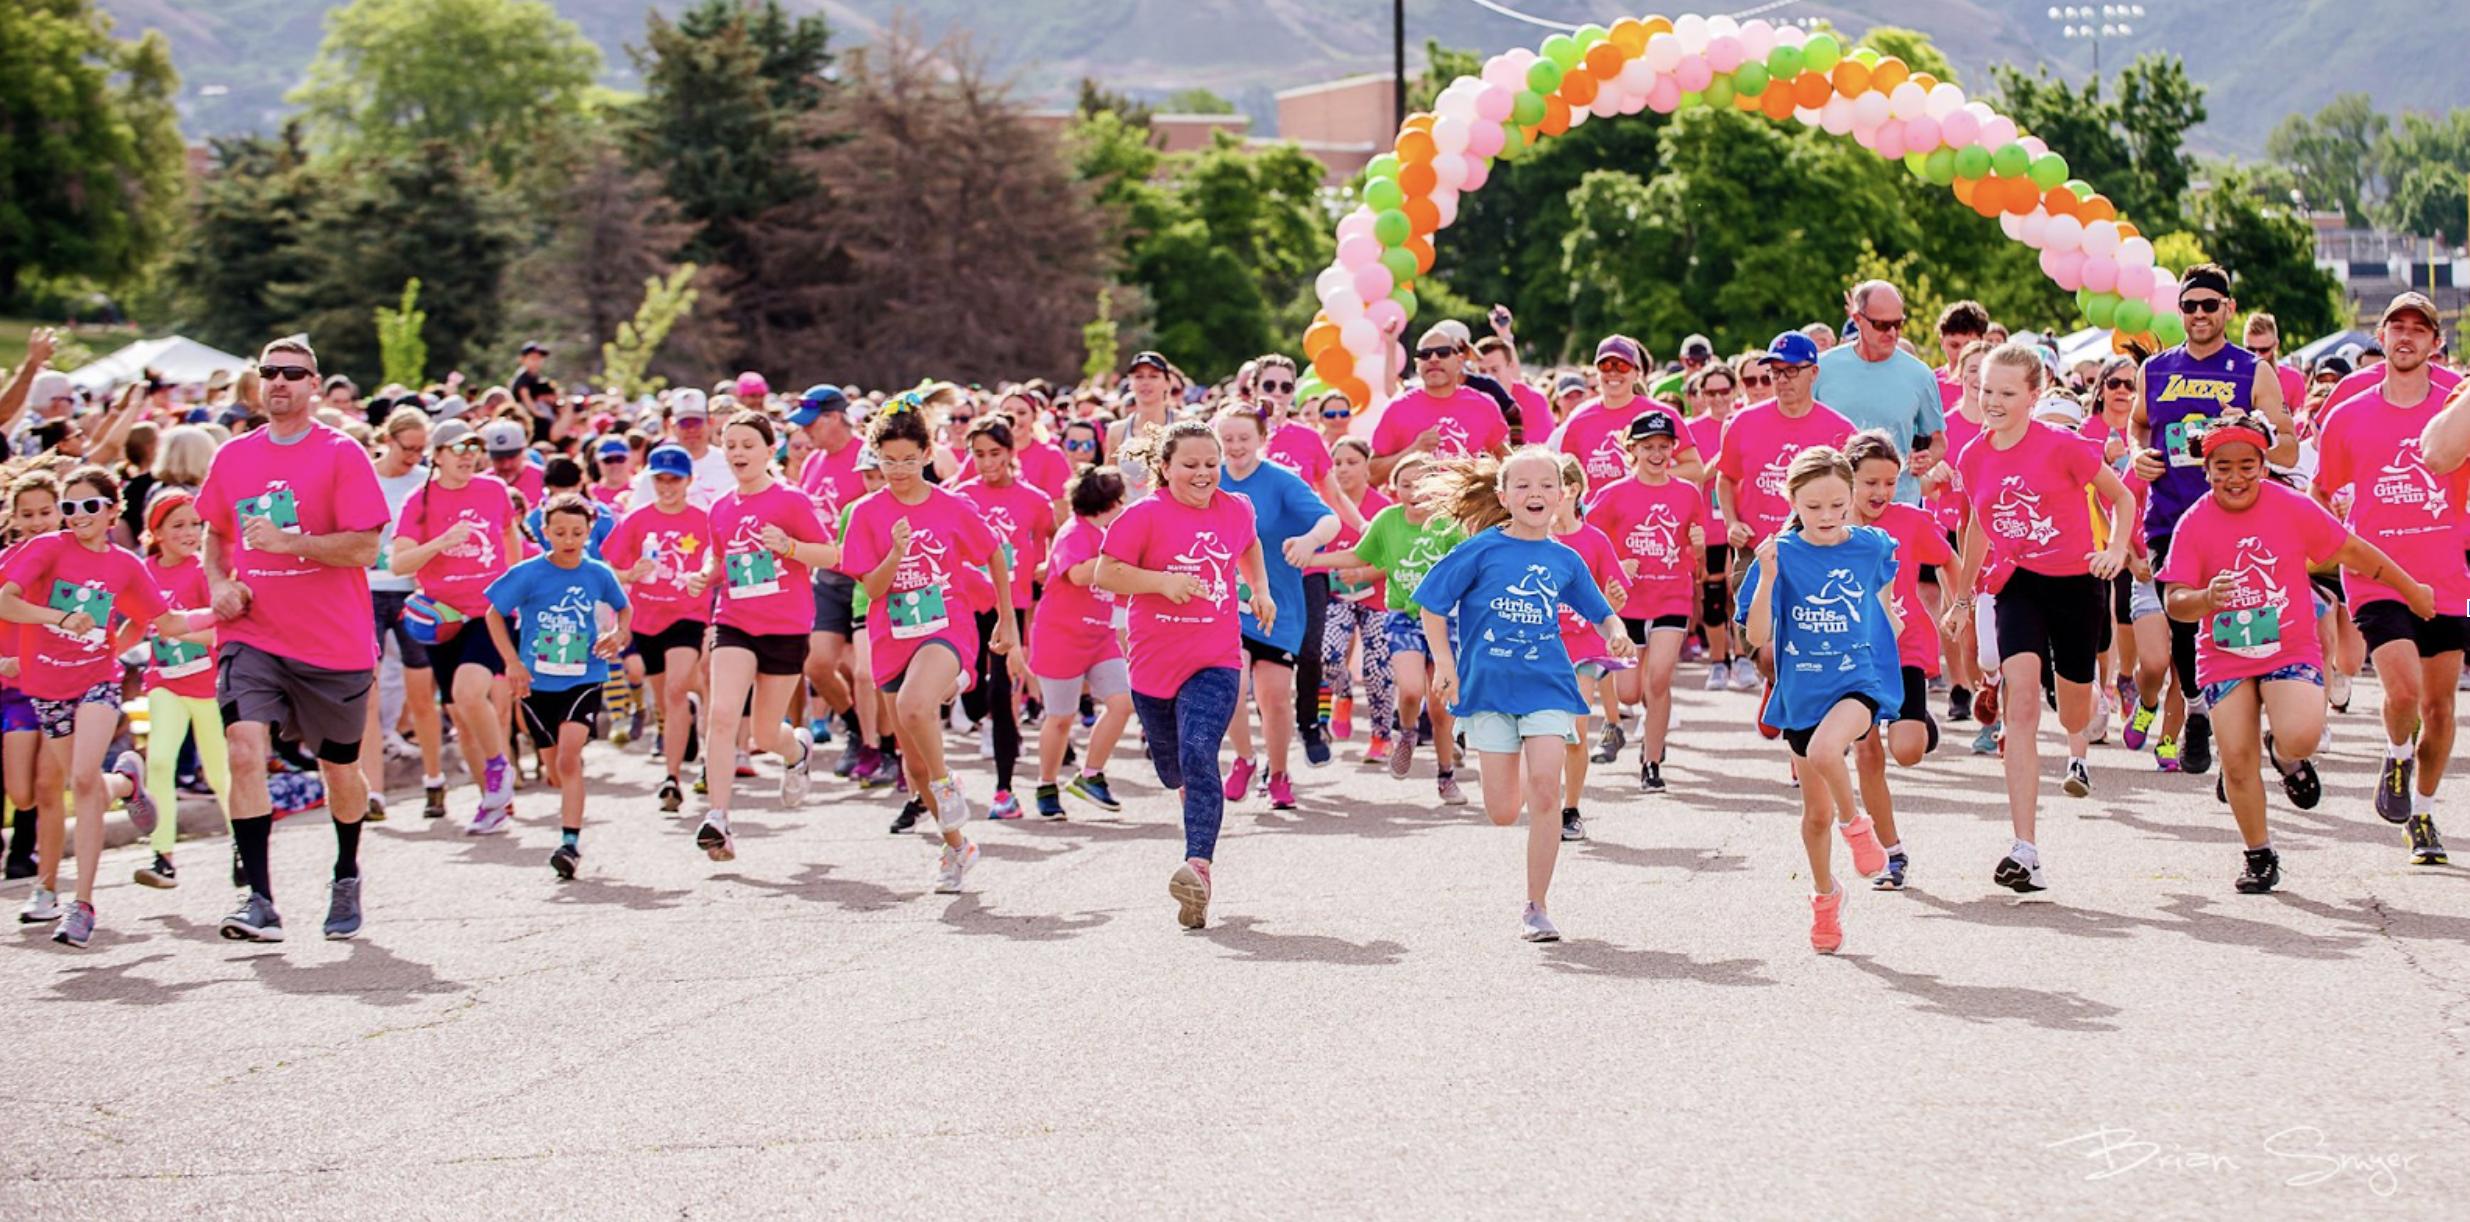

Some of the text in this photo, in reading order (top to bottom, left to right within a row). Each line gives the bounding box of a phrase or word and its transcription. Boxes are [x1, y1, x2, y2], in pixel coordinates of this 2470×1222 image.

[2156, 374, 2237, 404] LAKERS
[2374, 482, 2412, 497] Girls
[2394, 492, 2426, 504] run
[1625, 536, 1656, 549] Girls
[744, 567, 754, 585] 1
[1490, 597, 1533, 612] Girls
[910, 606, 922, 624] 1
[1510, 612, 1544, 625] run
[1793, 605, 1836, 622] Girls
[1812, 621, 1849, 634] run
[2240, 626, 2252, 646] 1
[172, 648, 186, 664] 1
[557, 646, 568, 663] 1
